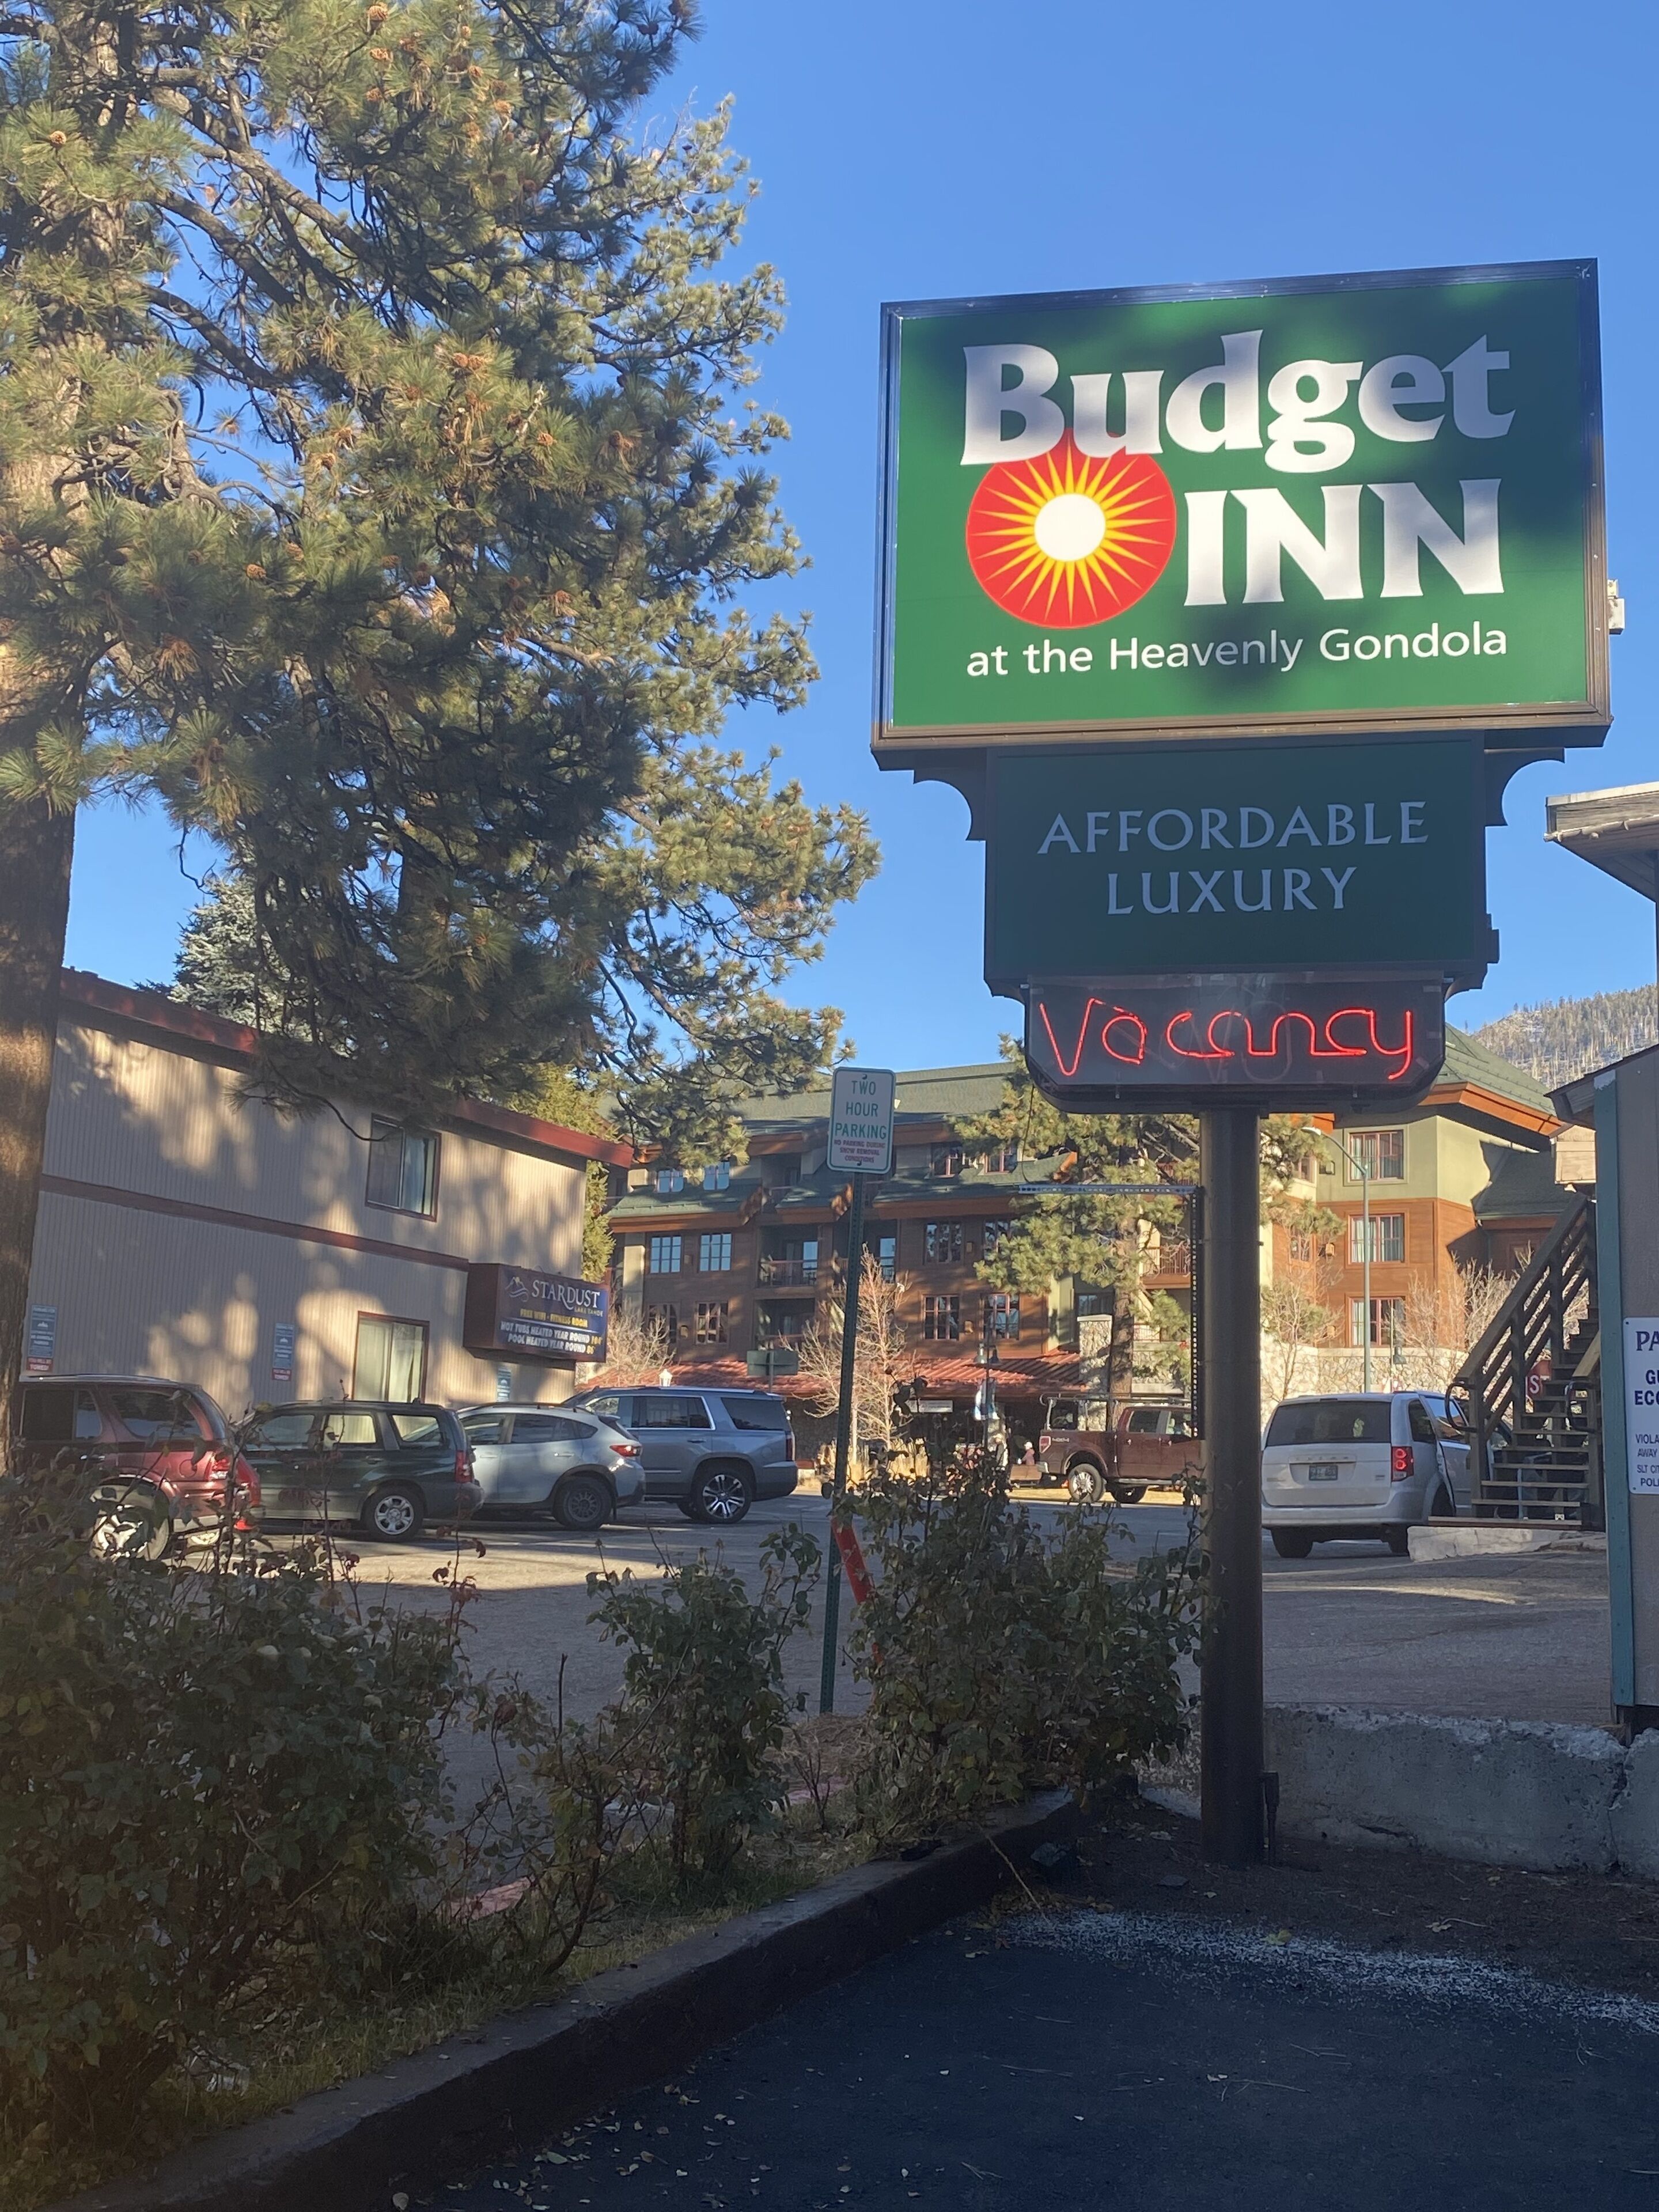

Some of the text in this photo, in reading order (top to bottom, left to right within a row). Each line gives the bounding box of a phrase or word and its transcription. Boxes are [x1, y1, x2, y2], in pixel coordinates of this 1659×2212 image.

[960, 329, 1516, 474] Budget
[1183, 478, 1504, 607] INN
[966, 620, 1508, 677] at the Heavenly Gondola
[1037, 801, 1429, 854] AFFORDABLE
[1107, 866, 1358, 915] LUXURY
[1039, 998, 1414, 1080] Vacancy
[851, 1081, 876, 1095] TWO
[846, 1102, 878, 1117] HOUR
[835, 1123, 887, 1139] PARKING
[532, 1280, 600, 1310] STARDUST
[501, 1320, 514, 1332] HOT
[515, 1323, 530, 1334] TUBS
[530, 1326, 553, 1338] HEATED
[554, 1329, 569, 1340] YEAR
[569, 1332, 590, 1344] ROUND
[507, 1333, 525, 1344] POOL
[525, 1336, 549, 1347] HEATED
[550, 1339, 565, 1350] YEAR
[565, 1342, 586, 1353] ROUND
[1645, 1369, 1659, 1385] G
[1638, 1448, 1657, 1457] AWAY
[1637, 1464, 1648, 1474] SLT
